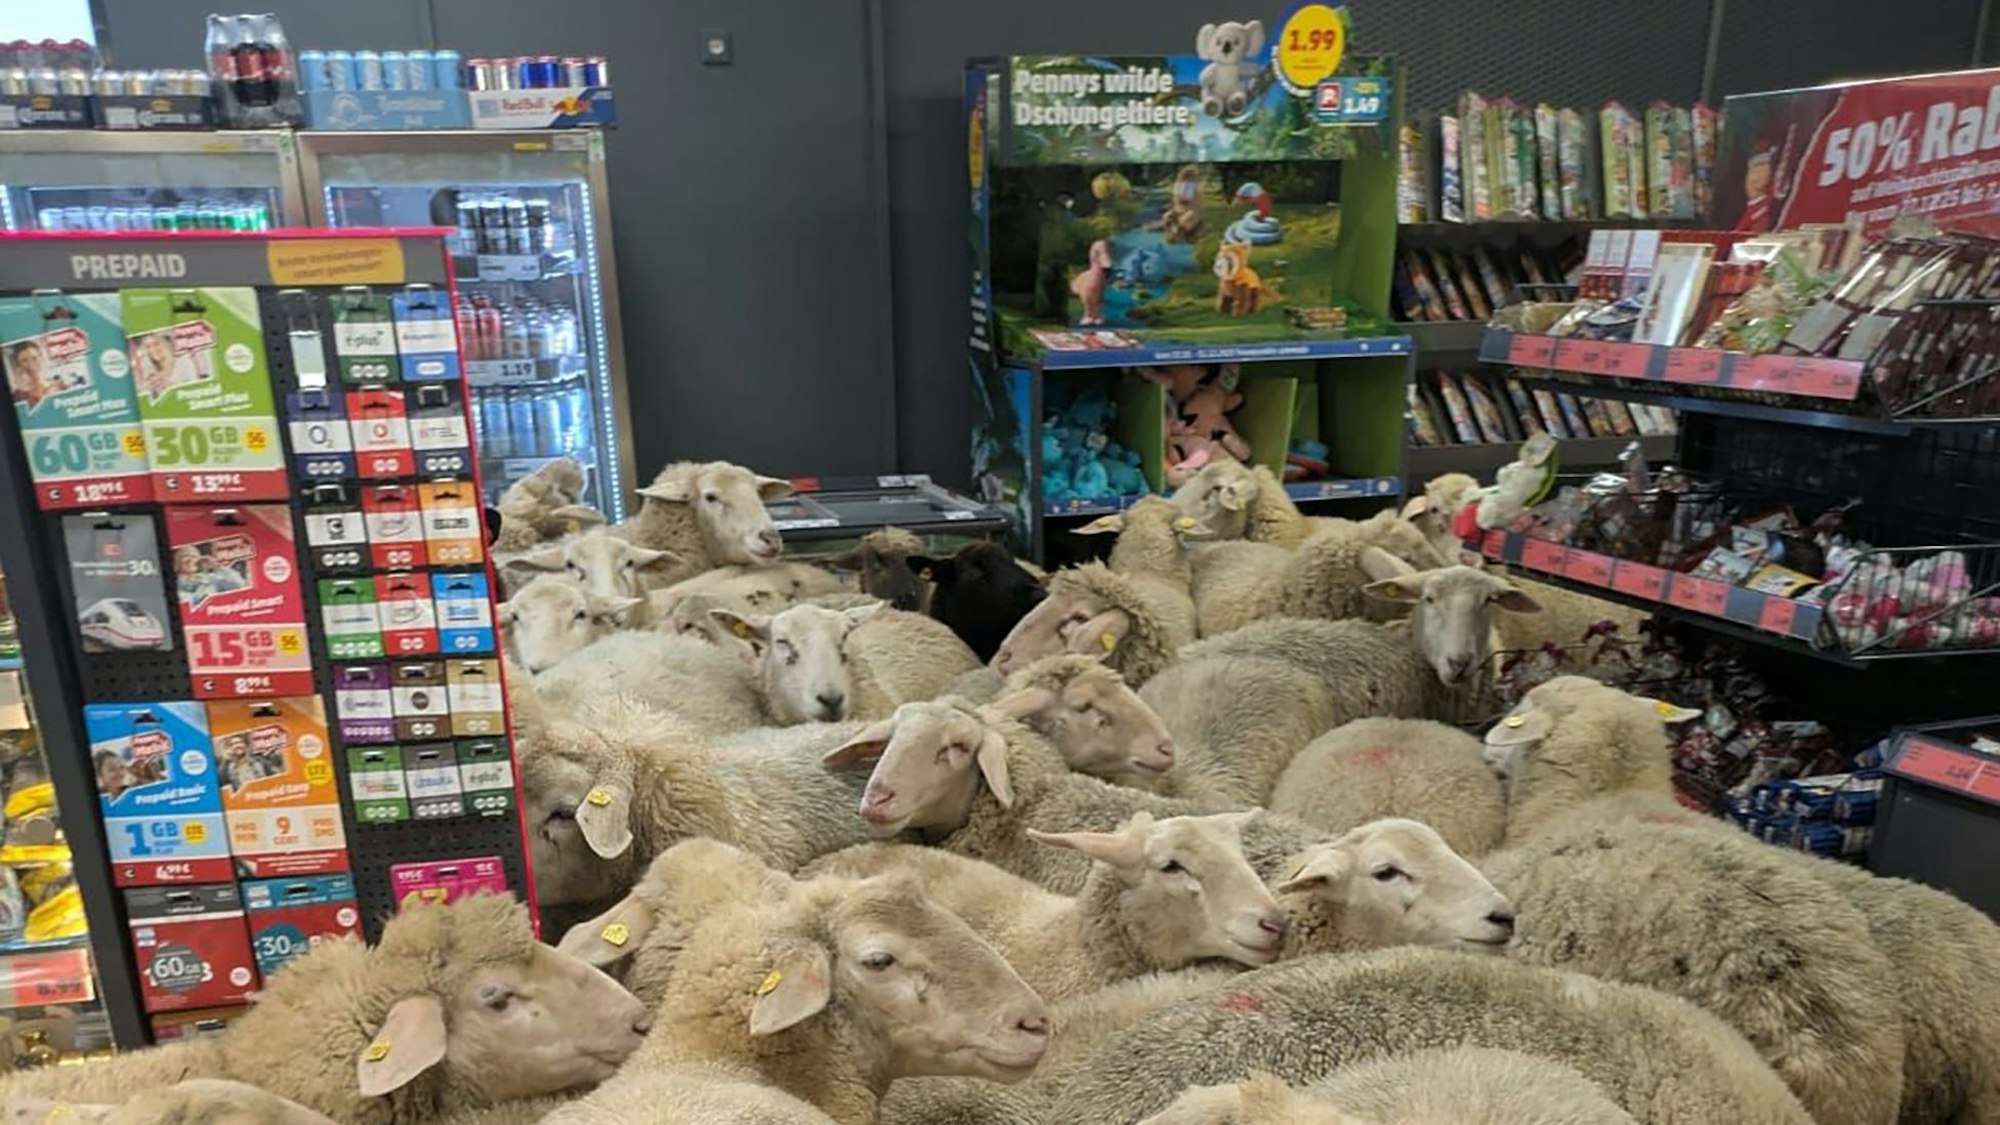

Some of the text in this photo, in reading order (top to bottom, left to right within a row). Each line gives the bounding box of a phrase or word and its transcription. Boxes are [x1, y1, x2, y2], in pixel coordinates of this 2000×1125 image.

[1289, 30, 1336, 51] 1.99
[1013, 66, 1173, 97] Pennys wilde
[1343, 97, 1380, 113] 1.49
[1817, 111, 1915, 187] 50%
[71, 253, 187, 279] PREPAID
[501, 363, 532, 378] 1.19
[153, 426, 209, 465] 30
[210, 426, 239, 443] GB
[247, 431, 265, 444] 5G
[33, 434, 89, 475] 60
[88, 431, 118, 451] GB
[128, 560, 152, 576] 30
[192, 632, 243, 667] 15
[244, 631, 273, 647] GB
[276, 815, 291, 835] 9
[125, 823, 152, 855] 1
[151, 822, 178, 837] GB
[261, 935, 291, 956] 30
[154, 956, 184, 978] 60
